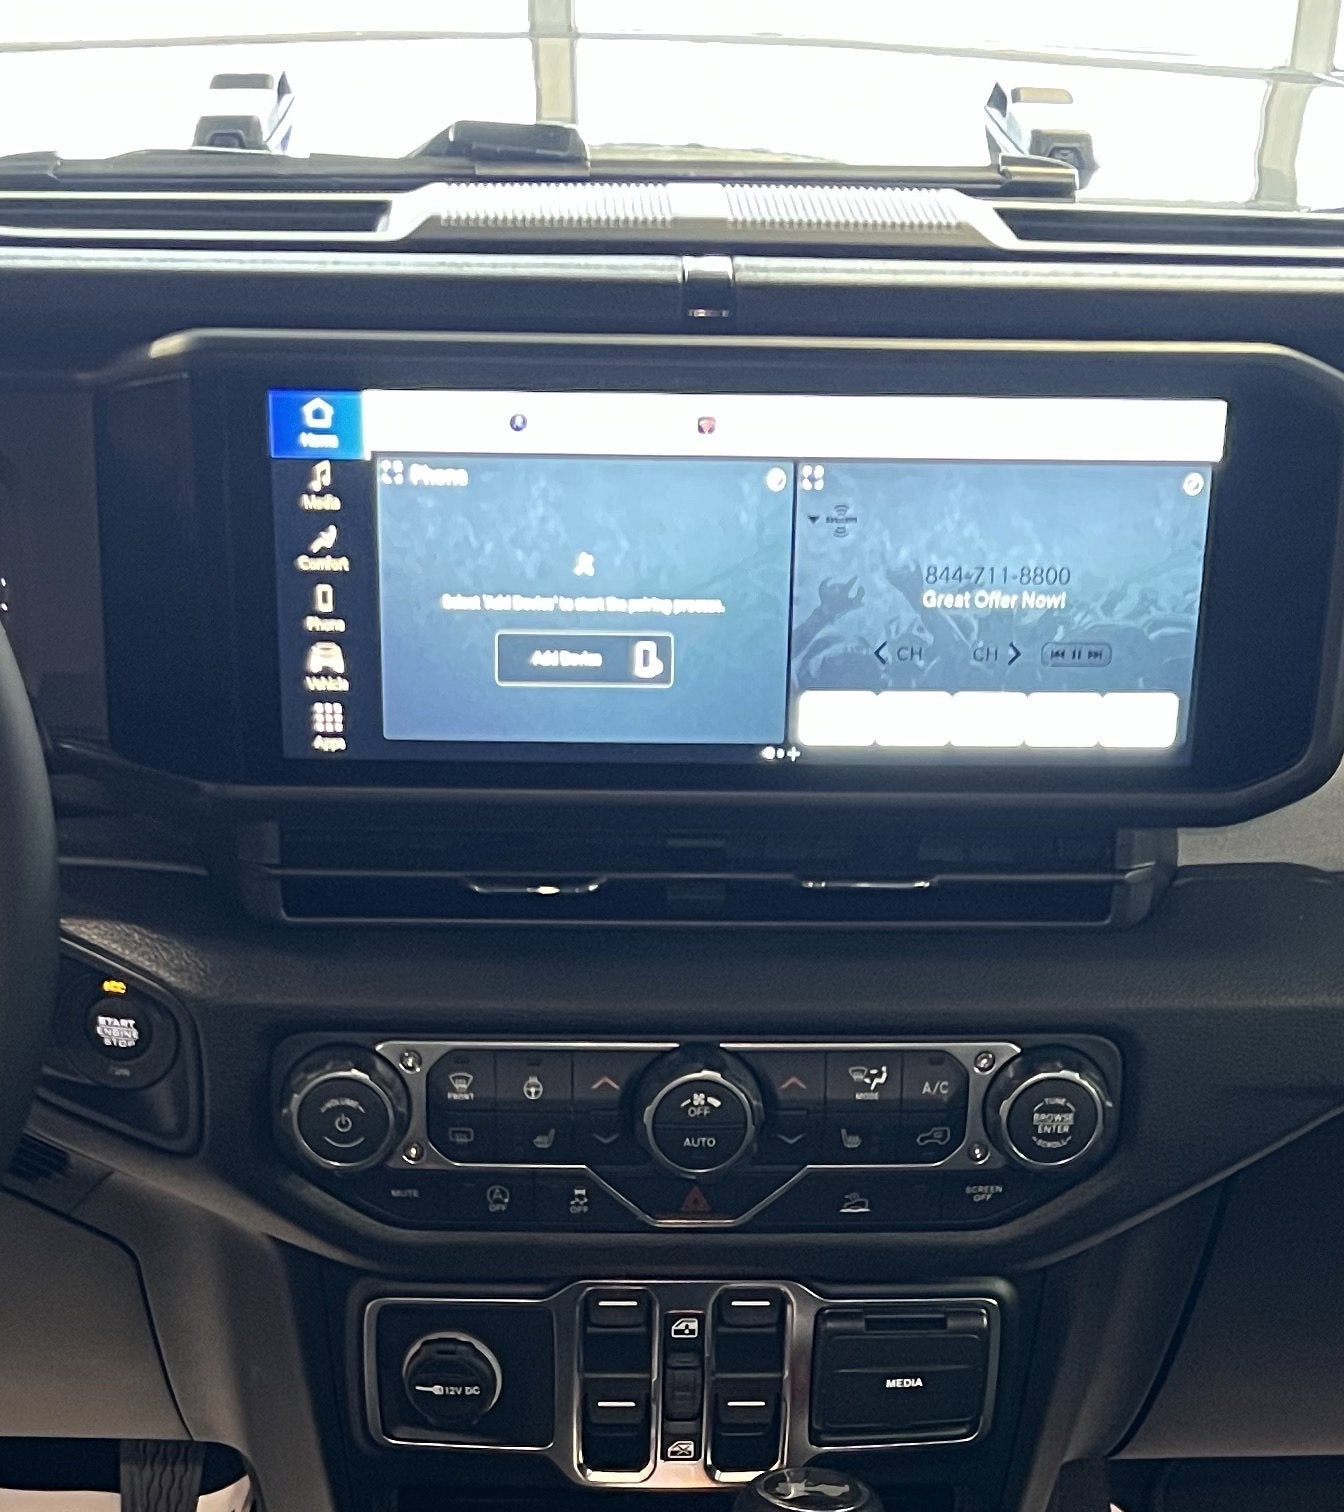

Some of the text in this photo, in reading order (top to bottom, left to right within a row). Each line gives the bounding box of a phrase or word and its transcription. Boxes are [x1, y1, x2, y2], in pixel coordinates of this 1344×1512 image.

[925, 565, 1071, 585] 844-711-8800
[922, 591, 1067, 609] Great Offer Now!
[896, 646, 923, 662] CH
[972, 647, 998, 662] CH
[98, 1016, 136, 1027] START
[96, 1026, 138, 1039] ENGINE
[104, 1037, 135, 1047] STOP
[922, 1081, 949, 1094] A/C
[687, 1107, 711, 1118] OFF
[1033, 1112, 1074, 1124] BROWSE
[1038, 1124, 1070, 1134] ENTER
[683, 1137, 716, 1148] AUTO
[391, 1189, 419, 1199] MUTE
[965, 1185, 1003, 1194] SCREEN
[973, 1194, 993, 1203] OFF
[488, 1203, 508, 1213] OFF
[569, 1206, 589, 1214] OFF
[885, 1377, 923, 1388] MEDIA
[445, 1386, 481, 1395] 12V DC
